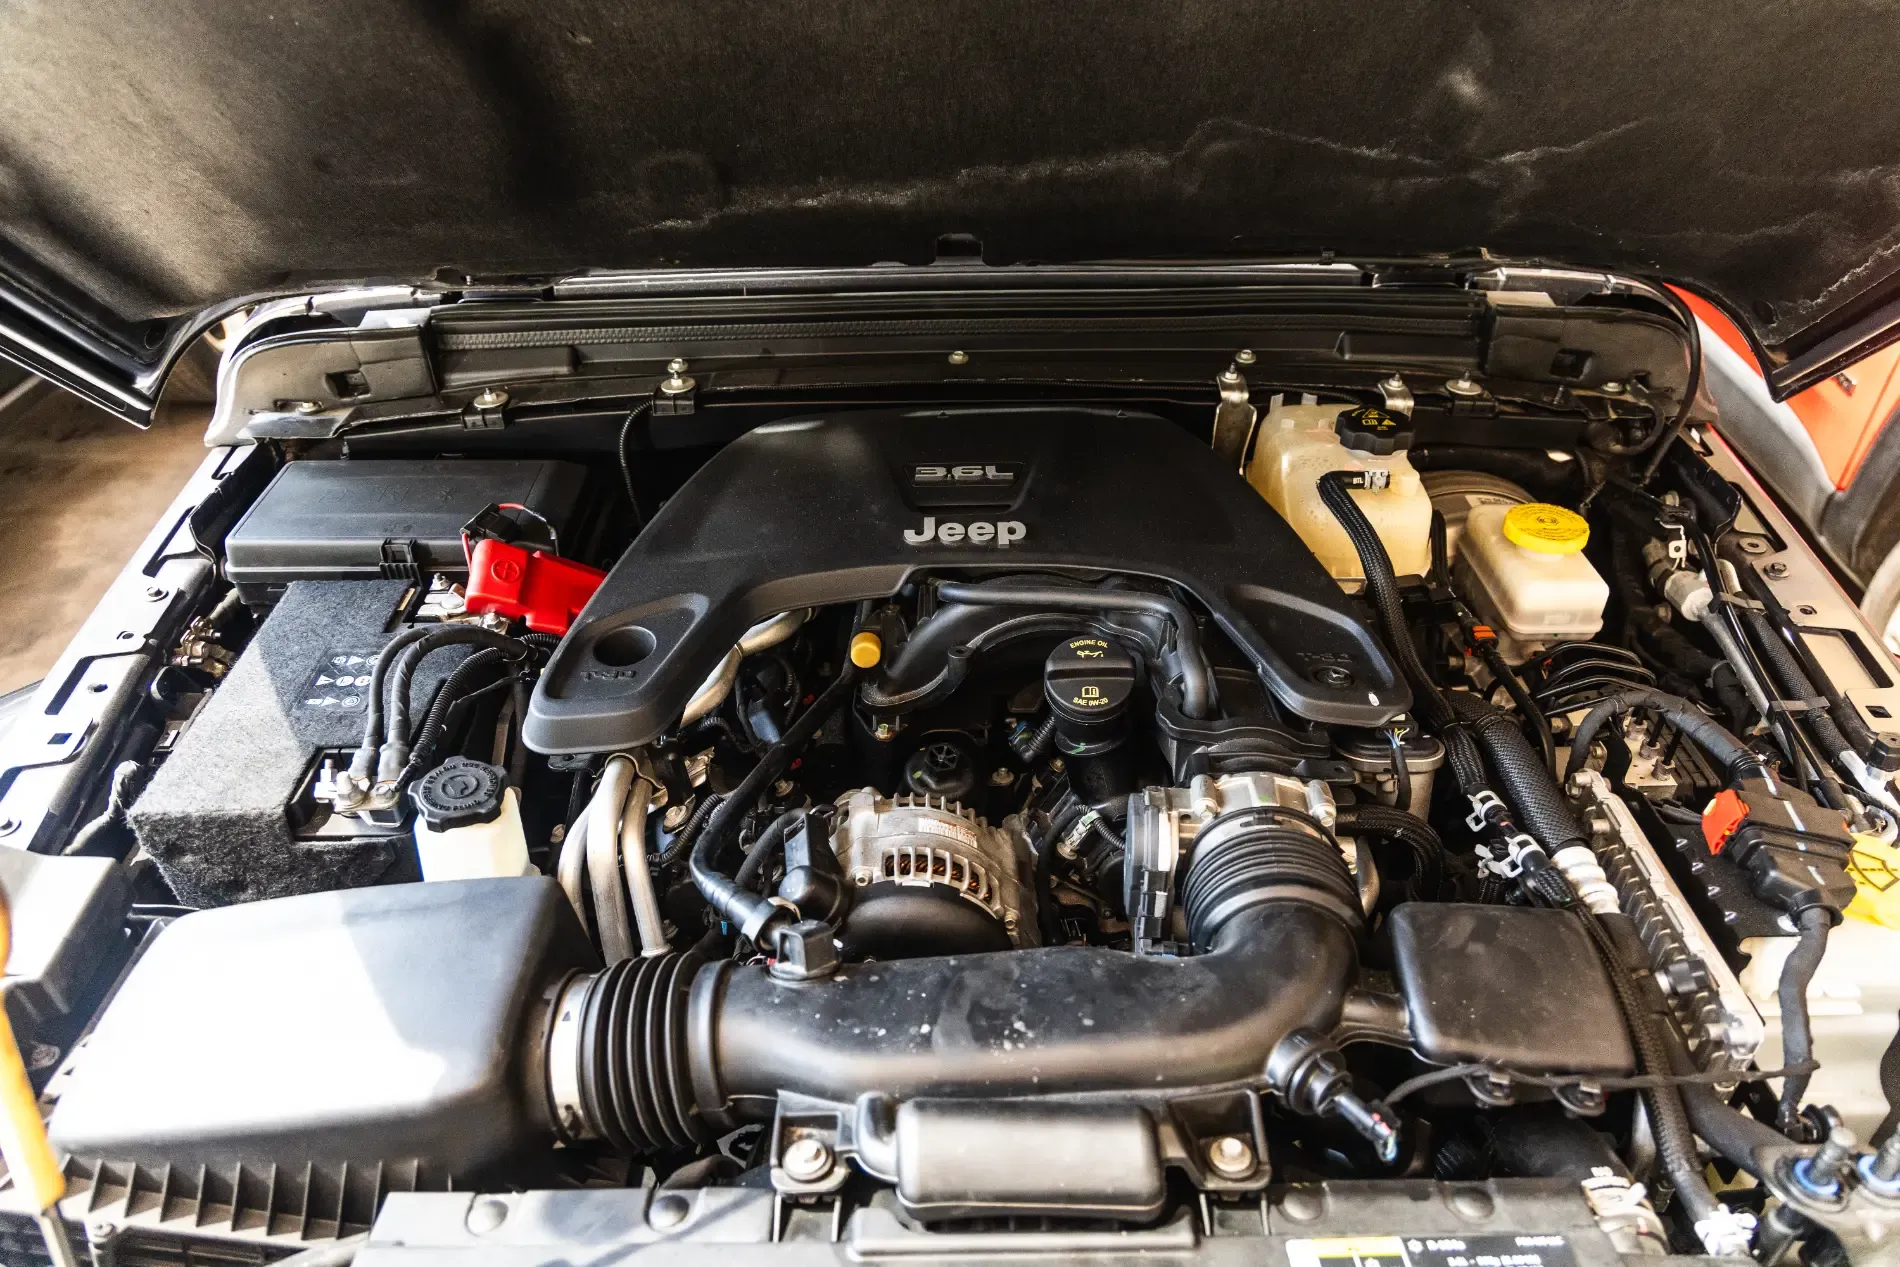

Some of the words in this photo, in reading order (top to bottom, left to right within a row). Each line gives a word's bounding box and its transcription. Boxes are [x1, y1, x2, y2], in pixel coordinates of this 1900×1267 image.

[914, 465, 1014, 481] 3.6L
[904, 517, 1027, 548] Jeep
[1069, 640, 1096, 649] ENGINE
[1097, 640, 1108, 649] OIL
[1072, 697, 1087, 706] SAE
[1088, 697, 1108, 706] 0W-20
